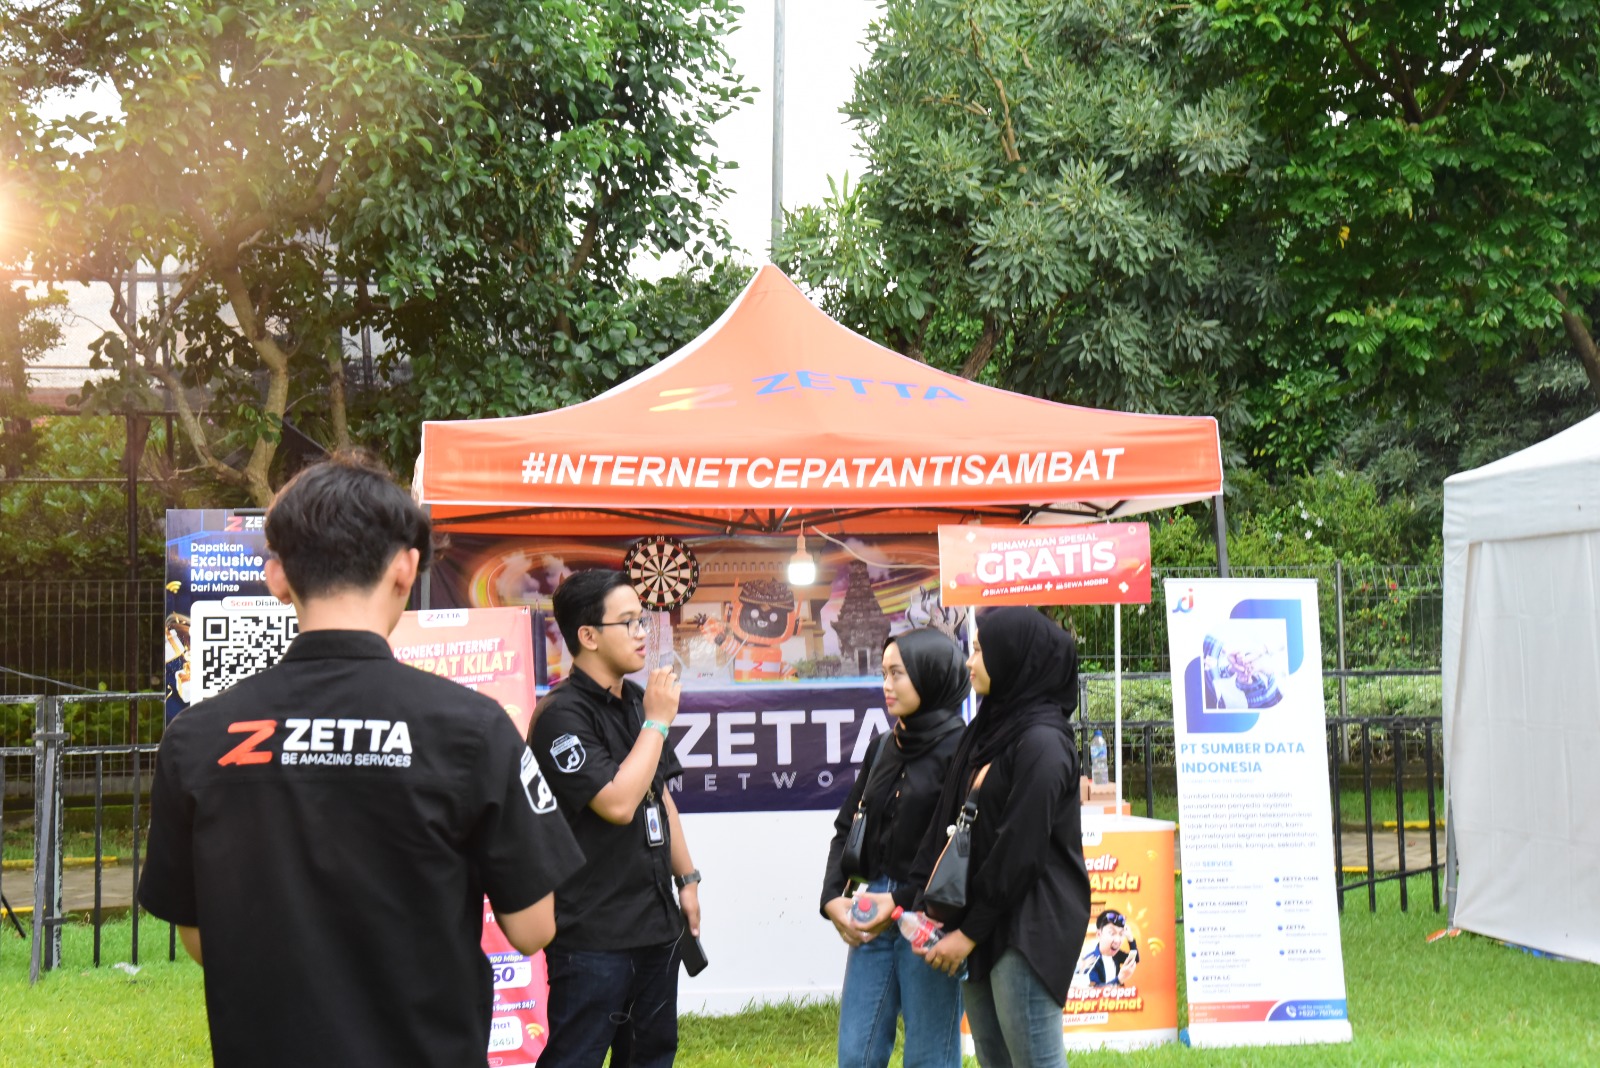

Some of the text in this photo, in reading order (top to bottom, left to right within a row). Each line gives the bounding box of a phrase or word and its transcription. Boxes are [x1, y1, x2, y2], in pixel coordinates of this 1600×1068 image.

[752, 370, 967, 402] ZETTA
[521, 447, 1125, 489] #INTERNETCEPATANTISAMBAT
[190, 543, 244, 554] Dapatkan
[991, 533, 1098, 551] PENAWARAN SPESIAL
[190, 554, 263, 567] Exclusive
[976, 541, 1117, 583] GRATIS
[190, 583, 239, 592] Dari Minze
[393, 638, 501, 660] KONEKSI INTERNET
[403, 651, 515, 677] EPAT KILAT
[283, 718, 413, 754] ZETTA
[1180, 742, 1305, 754] PT SUMBER DATA
[281, 752, 411, 767] BE AMAZING SERVICES
[1181, 761, 1262, 773] INDONESIA
[668, 769, 858, 792] NETWO
[1085, 854, 1117, 871] adir
[1090, 872, 1139, 890] Anda
[503, 954, 523, 963] Mbps
[1102, 986, 1136, 1000] Cepat
[1062, 997, 1142, 1014] uper Hemat
[491, 1022, 511, 1030] hat
